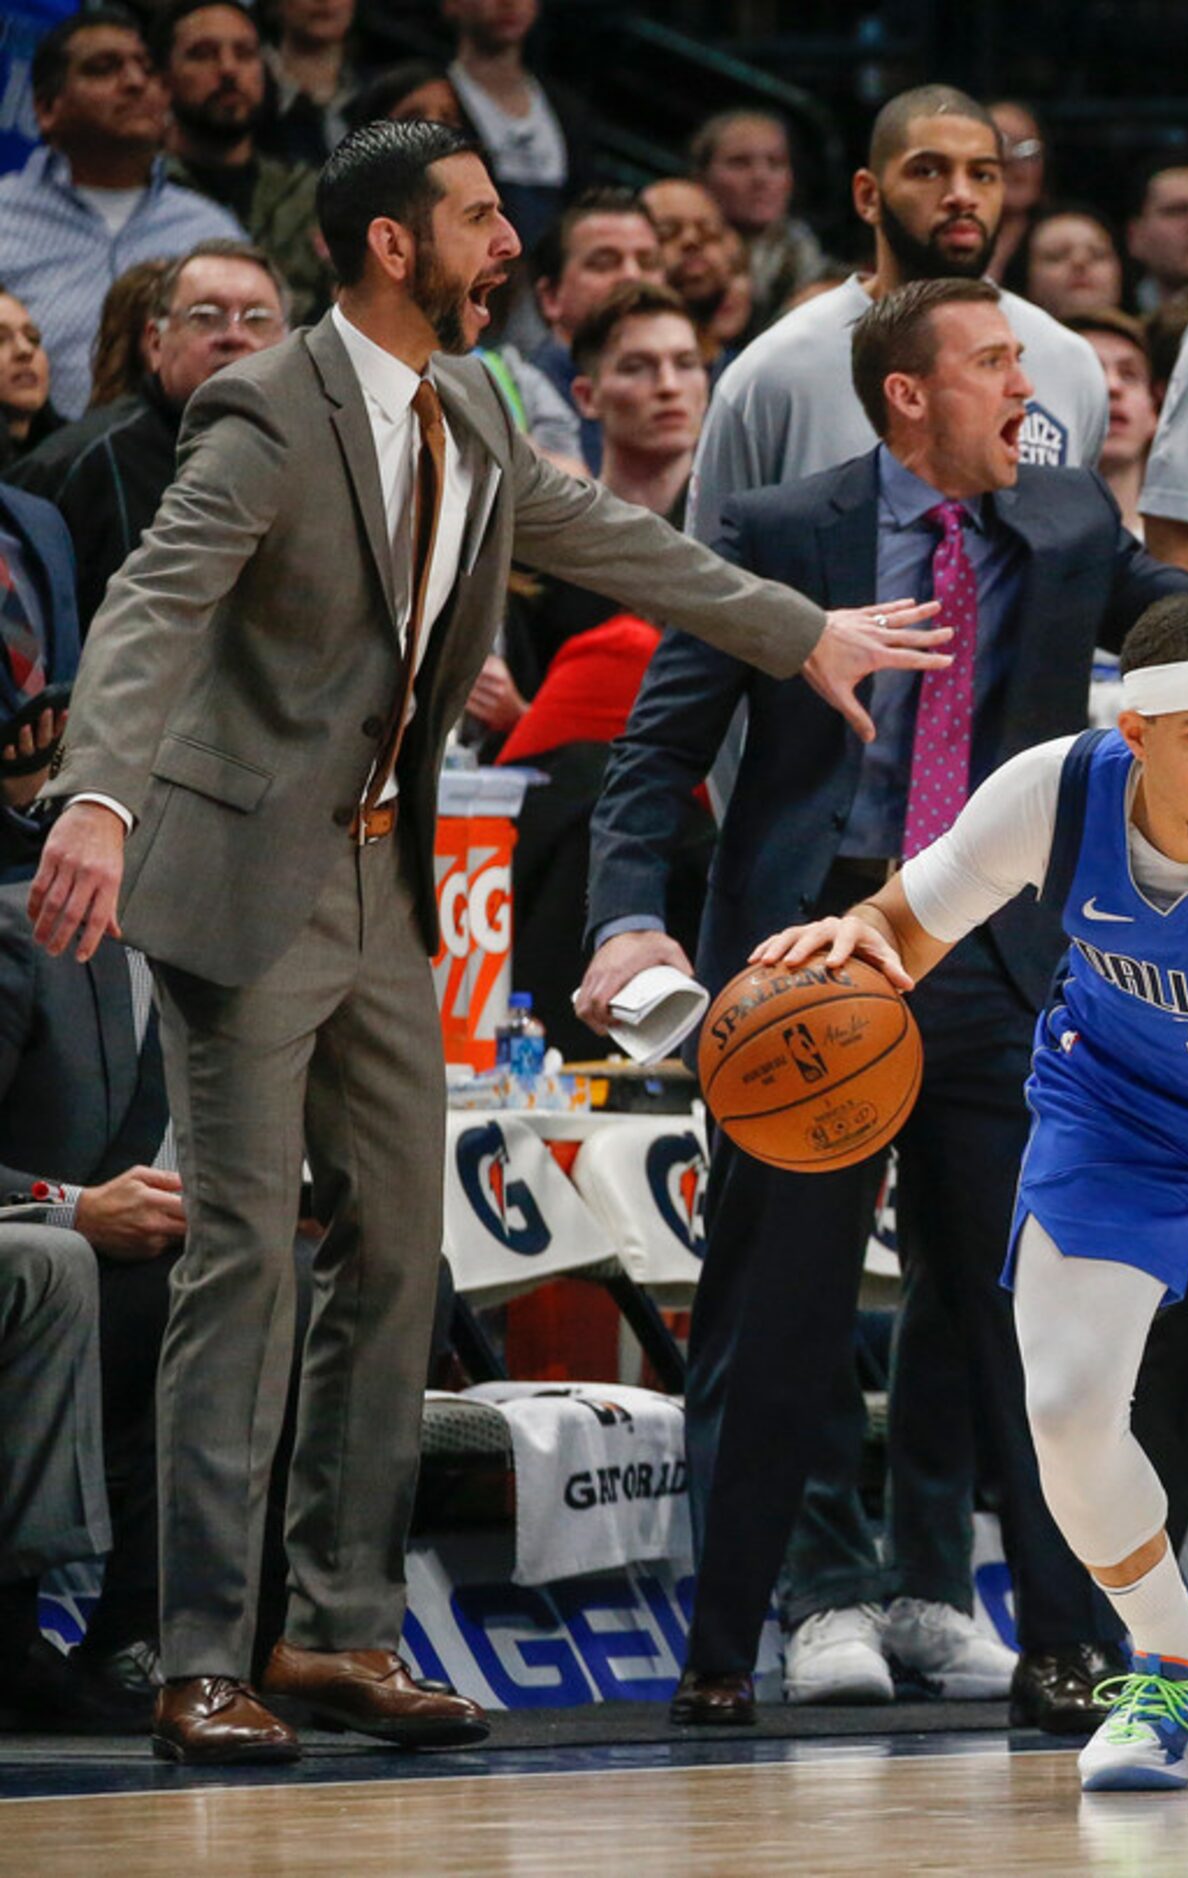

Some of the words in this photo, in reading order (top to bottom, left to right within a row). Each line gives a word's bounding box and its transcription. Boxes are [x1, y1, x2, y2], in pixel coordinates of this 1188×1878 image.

[456, 1120, 552, 1256] G
[564, 1460, 688, 1511] GATORAD
[450, 1574, 695, 1711] GEI
